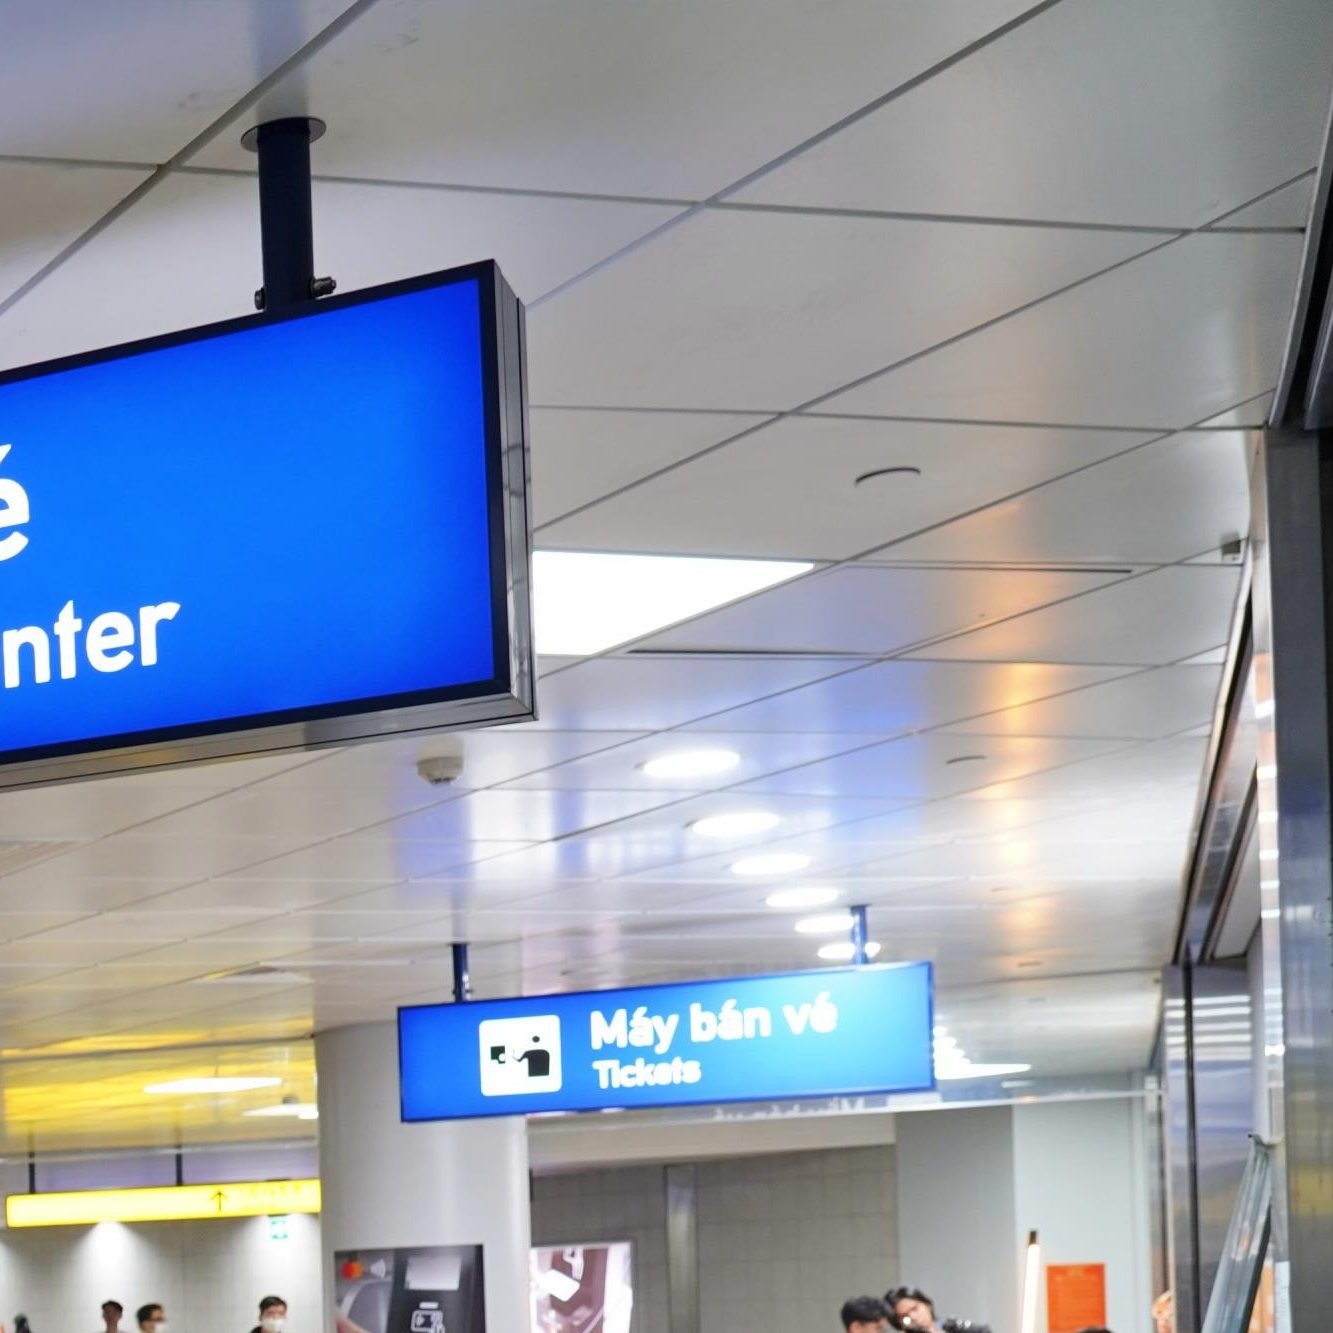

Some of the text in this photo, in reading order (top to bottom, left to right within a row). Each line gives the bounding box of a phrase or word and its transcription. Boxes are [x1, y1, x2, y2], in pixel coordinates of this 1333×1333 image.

[590, 991, 838, 1054] Máy bán vé
[592, 1057, 702, 1089] Tickets
